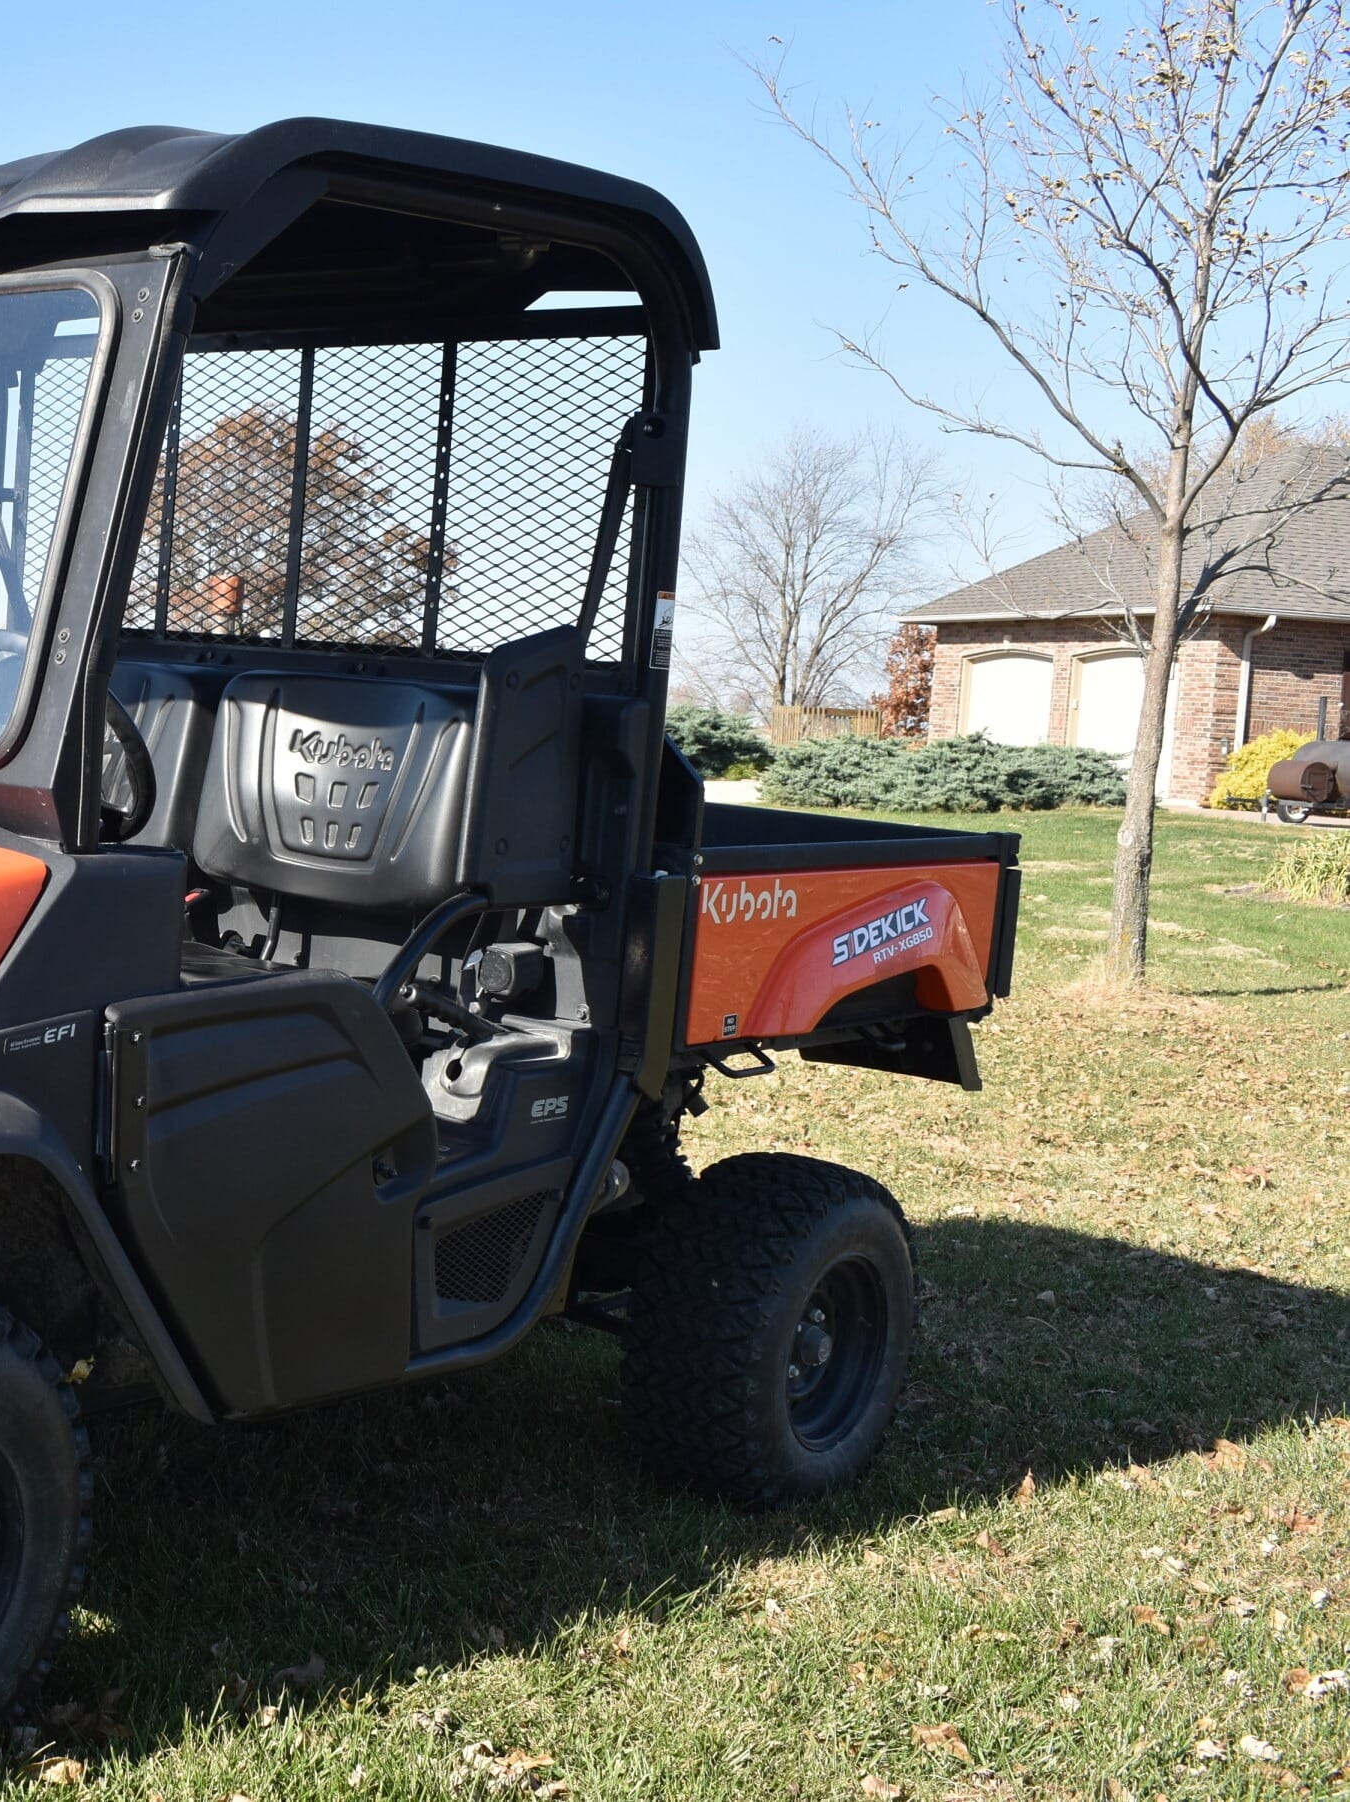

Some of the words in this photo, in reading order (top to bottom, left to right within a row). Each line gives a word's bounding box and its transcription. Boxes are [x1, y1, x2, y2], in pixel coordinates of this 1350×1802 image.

[289, 729, 394, 771] Kubota
[702, 879, 797, 924] Kubota
[832, 897, 930, 966] SIDEKICK
[873, 927, 933, 964] RTV-XG850
[44, 1023, 76, 1044] EFI
[531, 1096, 569, 1117] EPS
